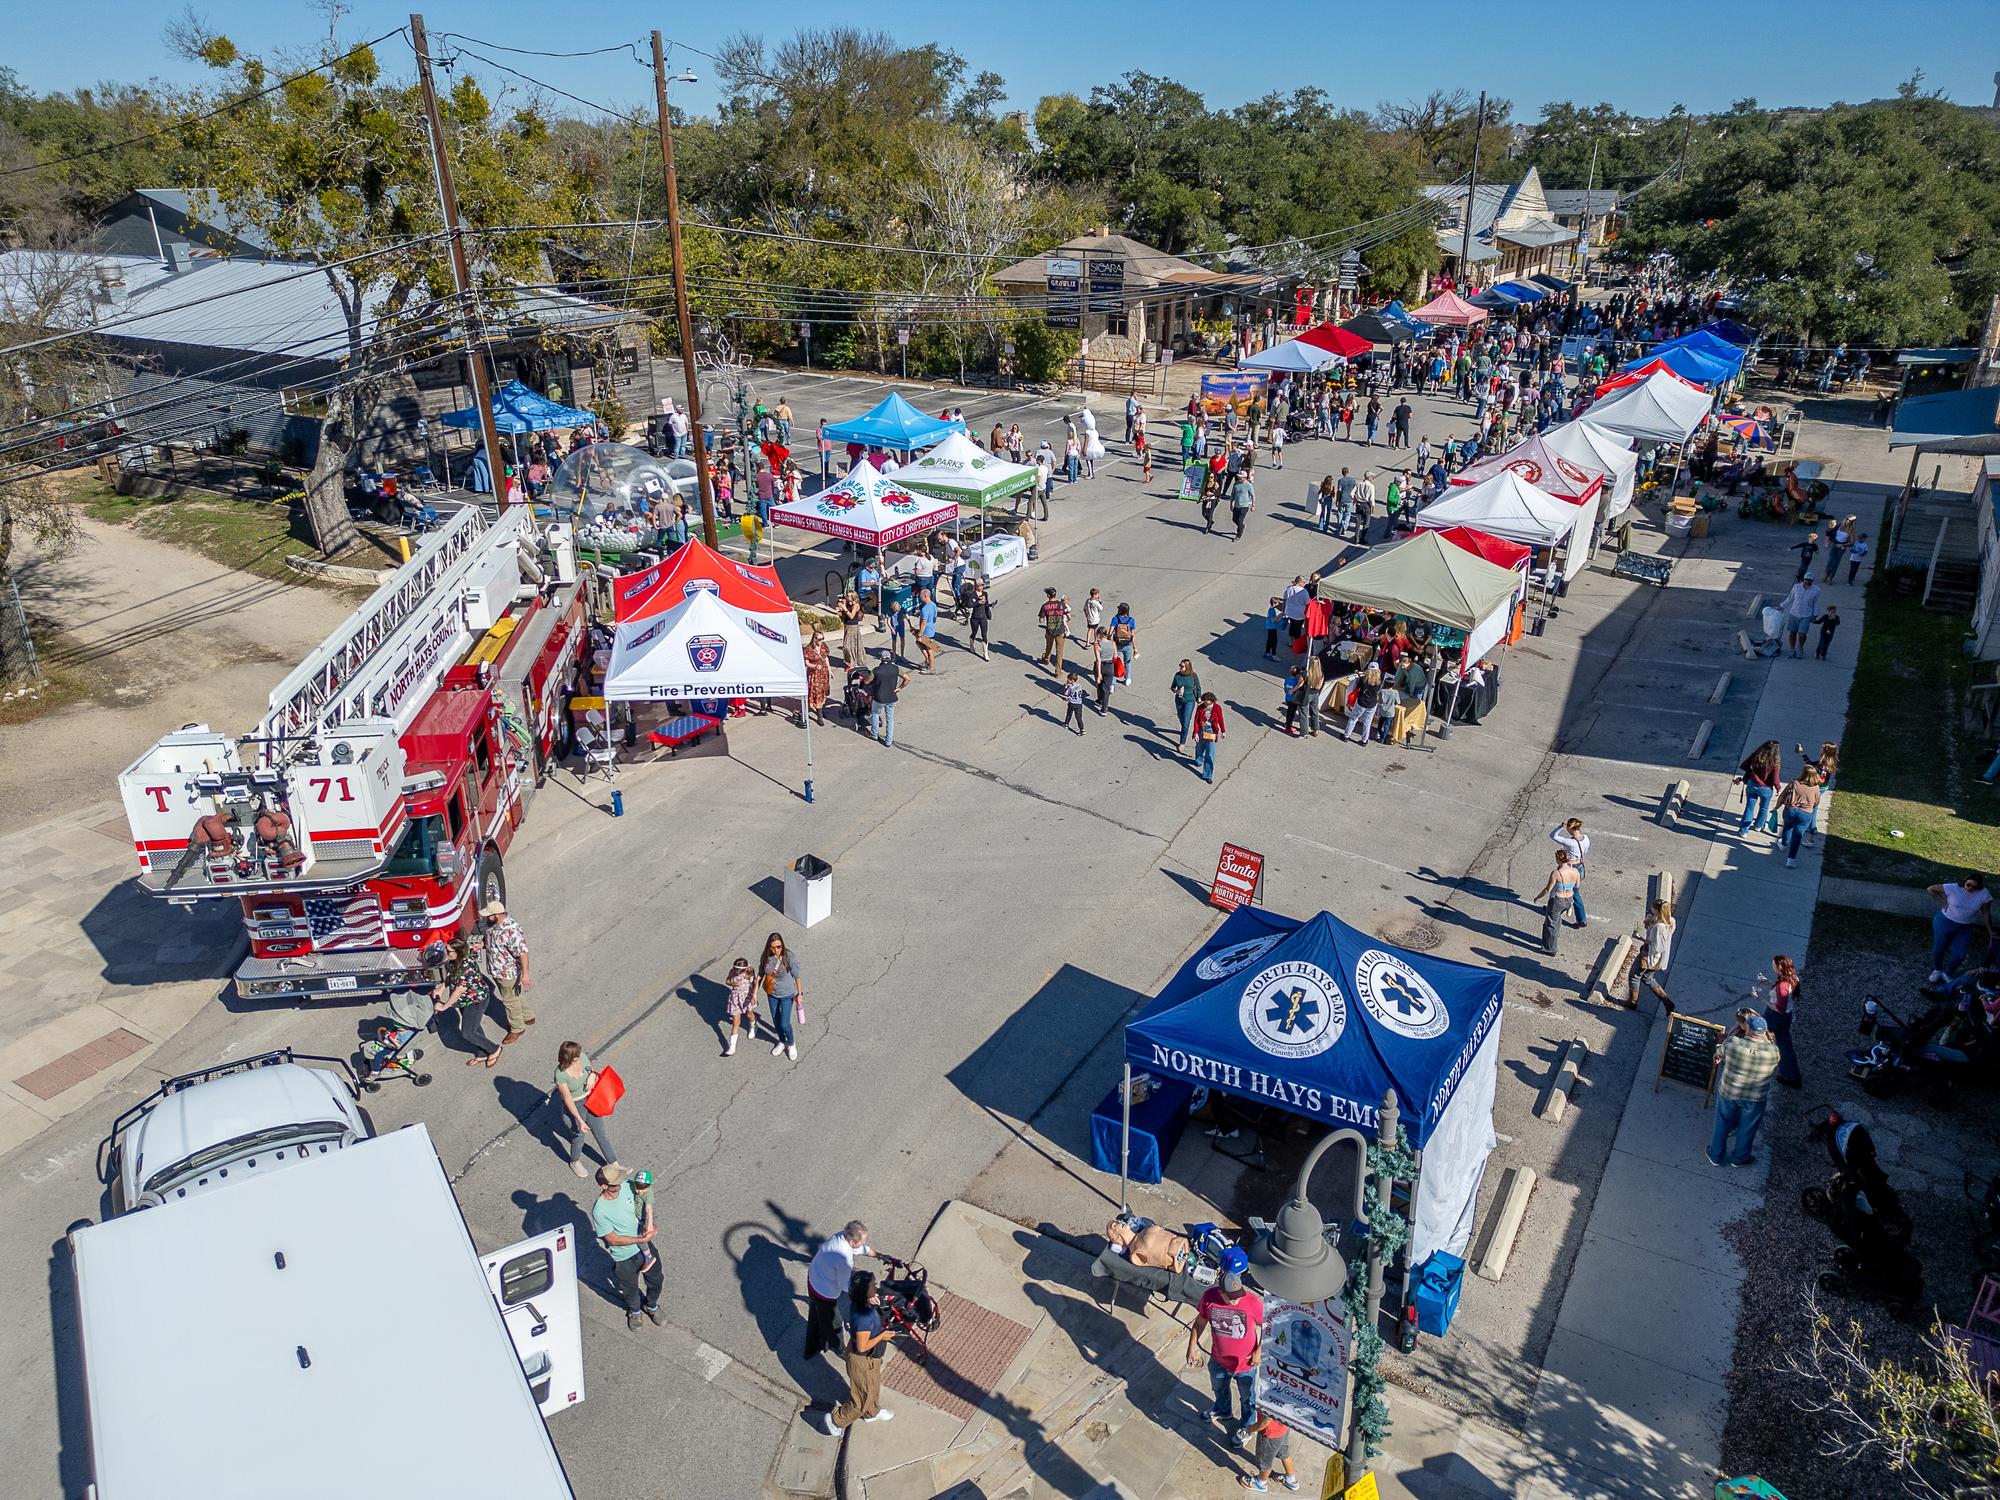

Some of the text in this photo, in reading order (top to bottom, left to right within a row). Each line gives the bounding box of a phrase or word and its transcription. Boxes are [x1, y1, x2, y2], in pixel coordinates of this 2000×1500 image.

[936, 458, 964, 469] PARKS
[830, 480, 865, 497] FARMERS
[941, 492, 970, 502] SPRINGS
[816, 504, 848, 516] MARKET
[780, 513, 875, 543] DRIPPING SPRINGS FARMERS MARKET
[882, 507, 956, 543] CITY OF DRIPPING SPRINGS
[390, 616, 456, 711] NORTH HAYS COUNTY
[650, 683, 764, 697] Fire Prevention
[145, 786, 171, 813] T
[310, 777, 355, 802] 71
[1220, 854, 1258, 879] Santa
[1215, 886, 1234, 900] NORTH
[1234, 894, 1250, 905] POLE
[1246, 963, 1345, 1025] NORTH HAYS EMS
[1358, 952, 1415, 1019] NORTH HAYS EMS
[1257, 1041, 1270, 1054] Hays
[1271, 1048, 1295, 1057] County
[1432, 993, 1498, 1124] NORTH HAYS EMS
[1152, 1044, 1242, 1089] NORTH
[1250, 1070, 1322, 1112] HAYS
[1266, 1306, 1281, 1337] DRIPPING
[1280, 1304, 1317, 1318] SPRINGS
[1318, 1316, 1342, 1343] RANCH
[1339, 1343, 1347, 1367] PARK
[1266, 1365, 1340, 1409] WESTERN
[1270, 1378, 1332, 1417] Wonderland
